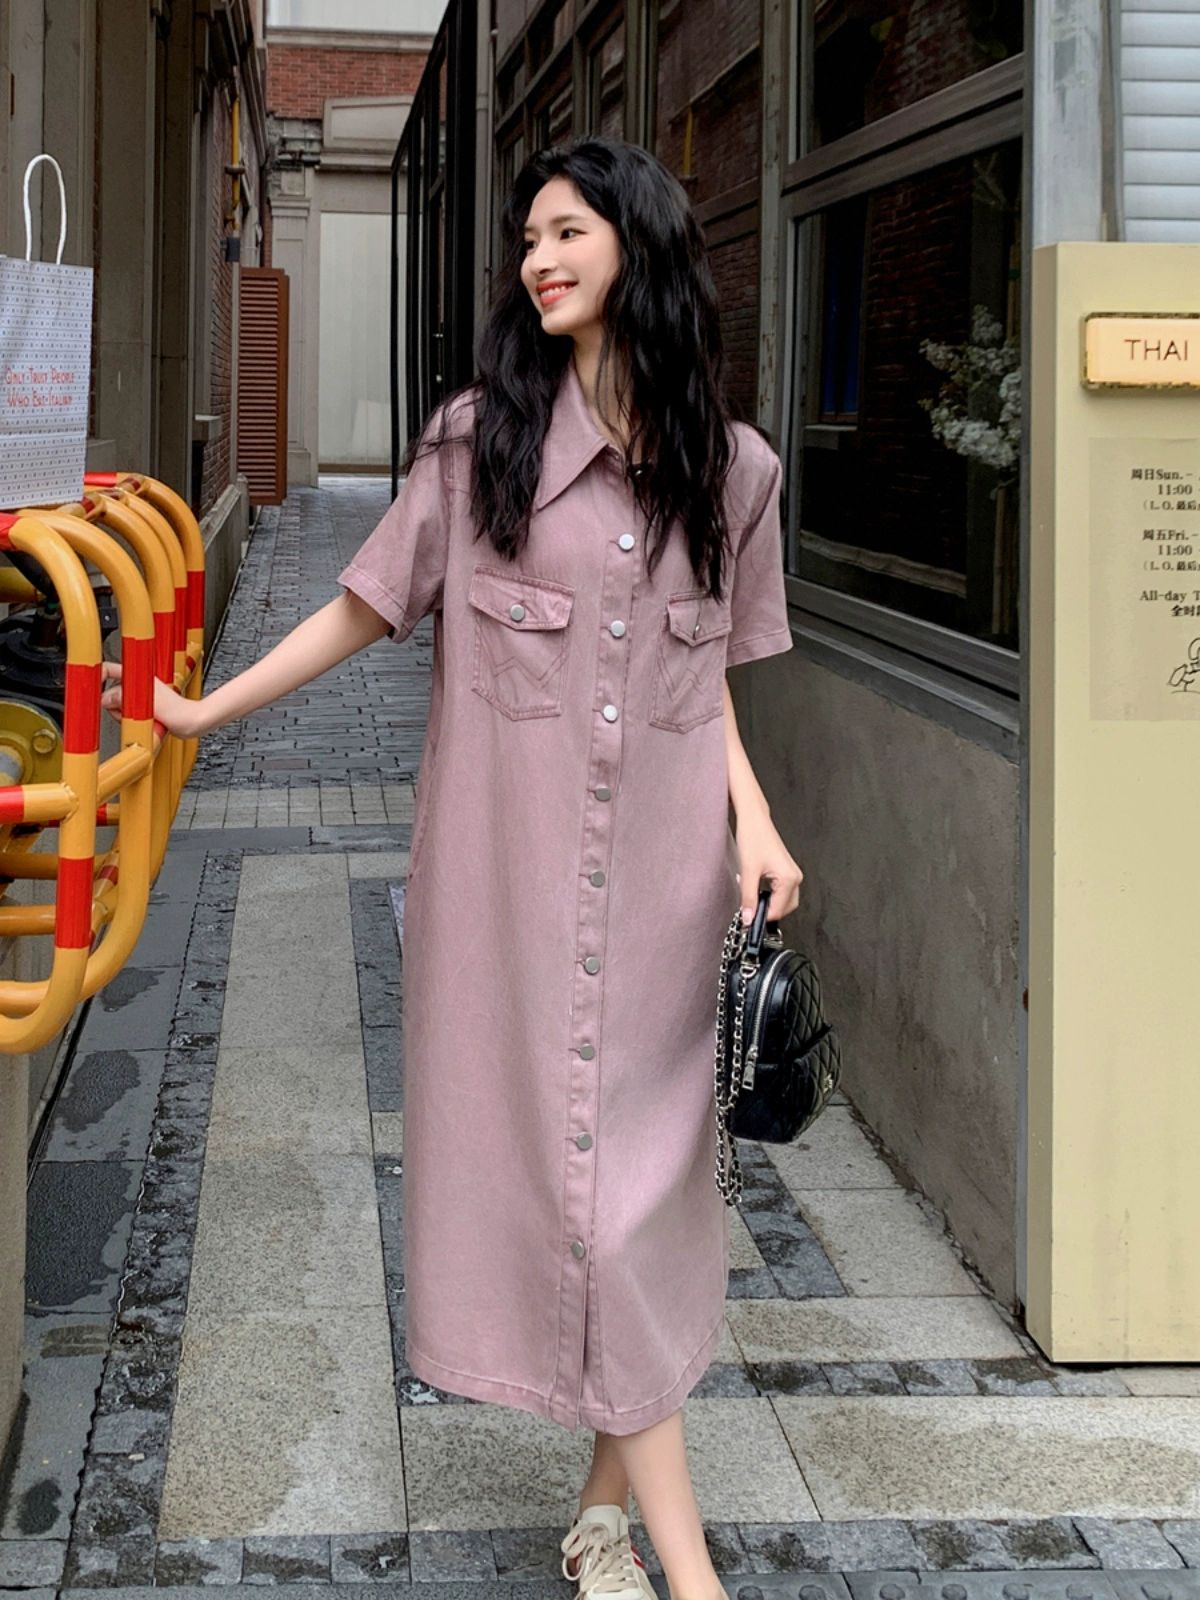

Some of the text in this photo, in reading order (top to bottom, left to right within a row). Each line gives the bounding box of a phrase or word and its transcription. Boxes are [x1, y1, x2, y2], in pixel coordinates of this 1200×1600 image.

[1124, 339, 1188, 361] THAI
[1158, 484, 1193, 496] 11:00
[1158, 545, 1193, 556] 11:00
[1140, 590, 1188, 603] All-day
